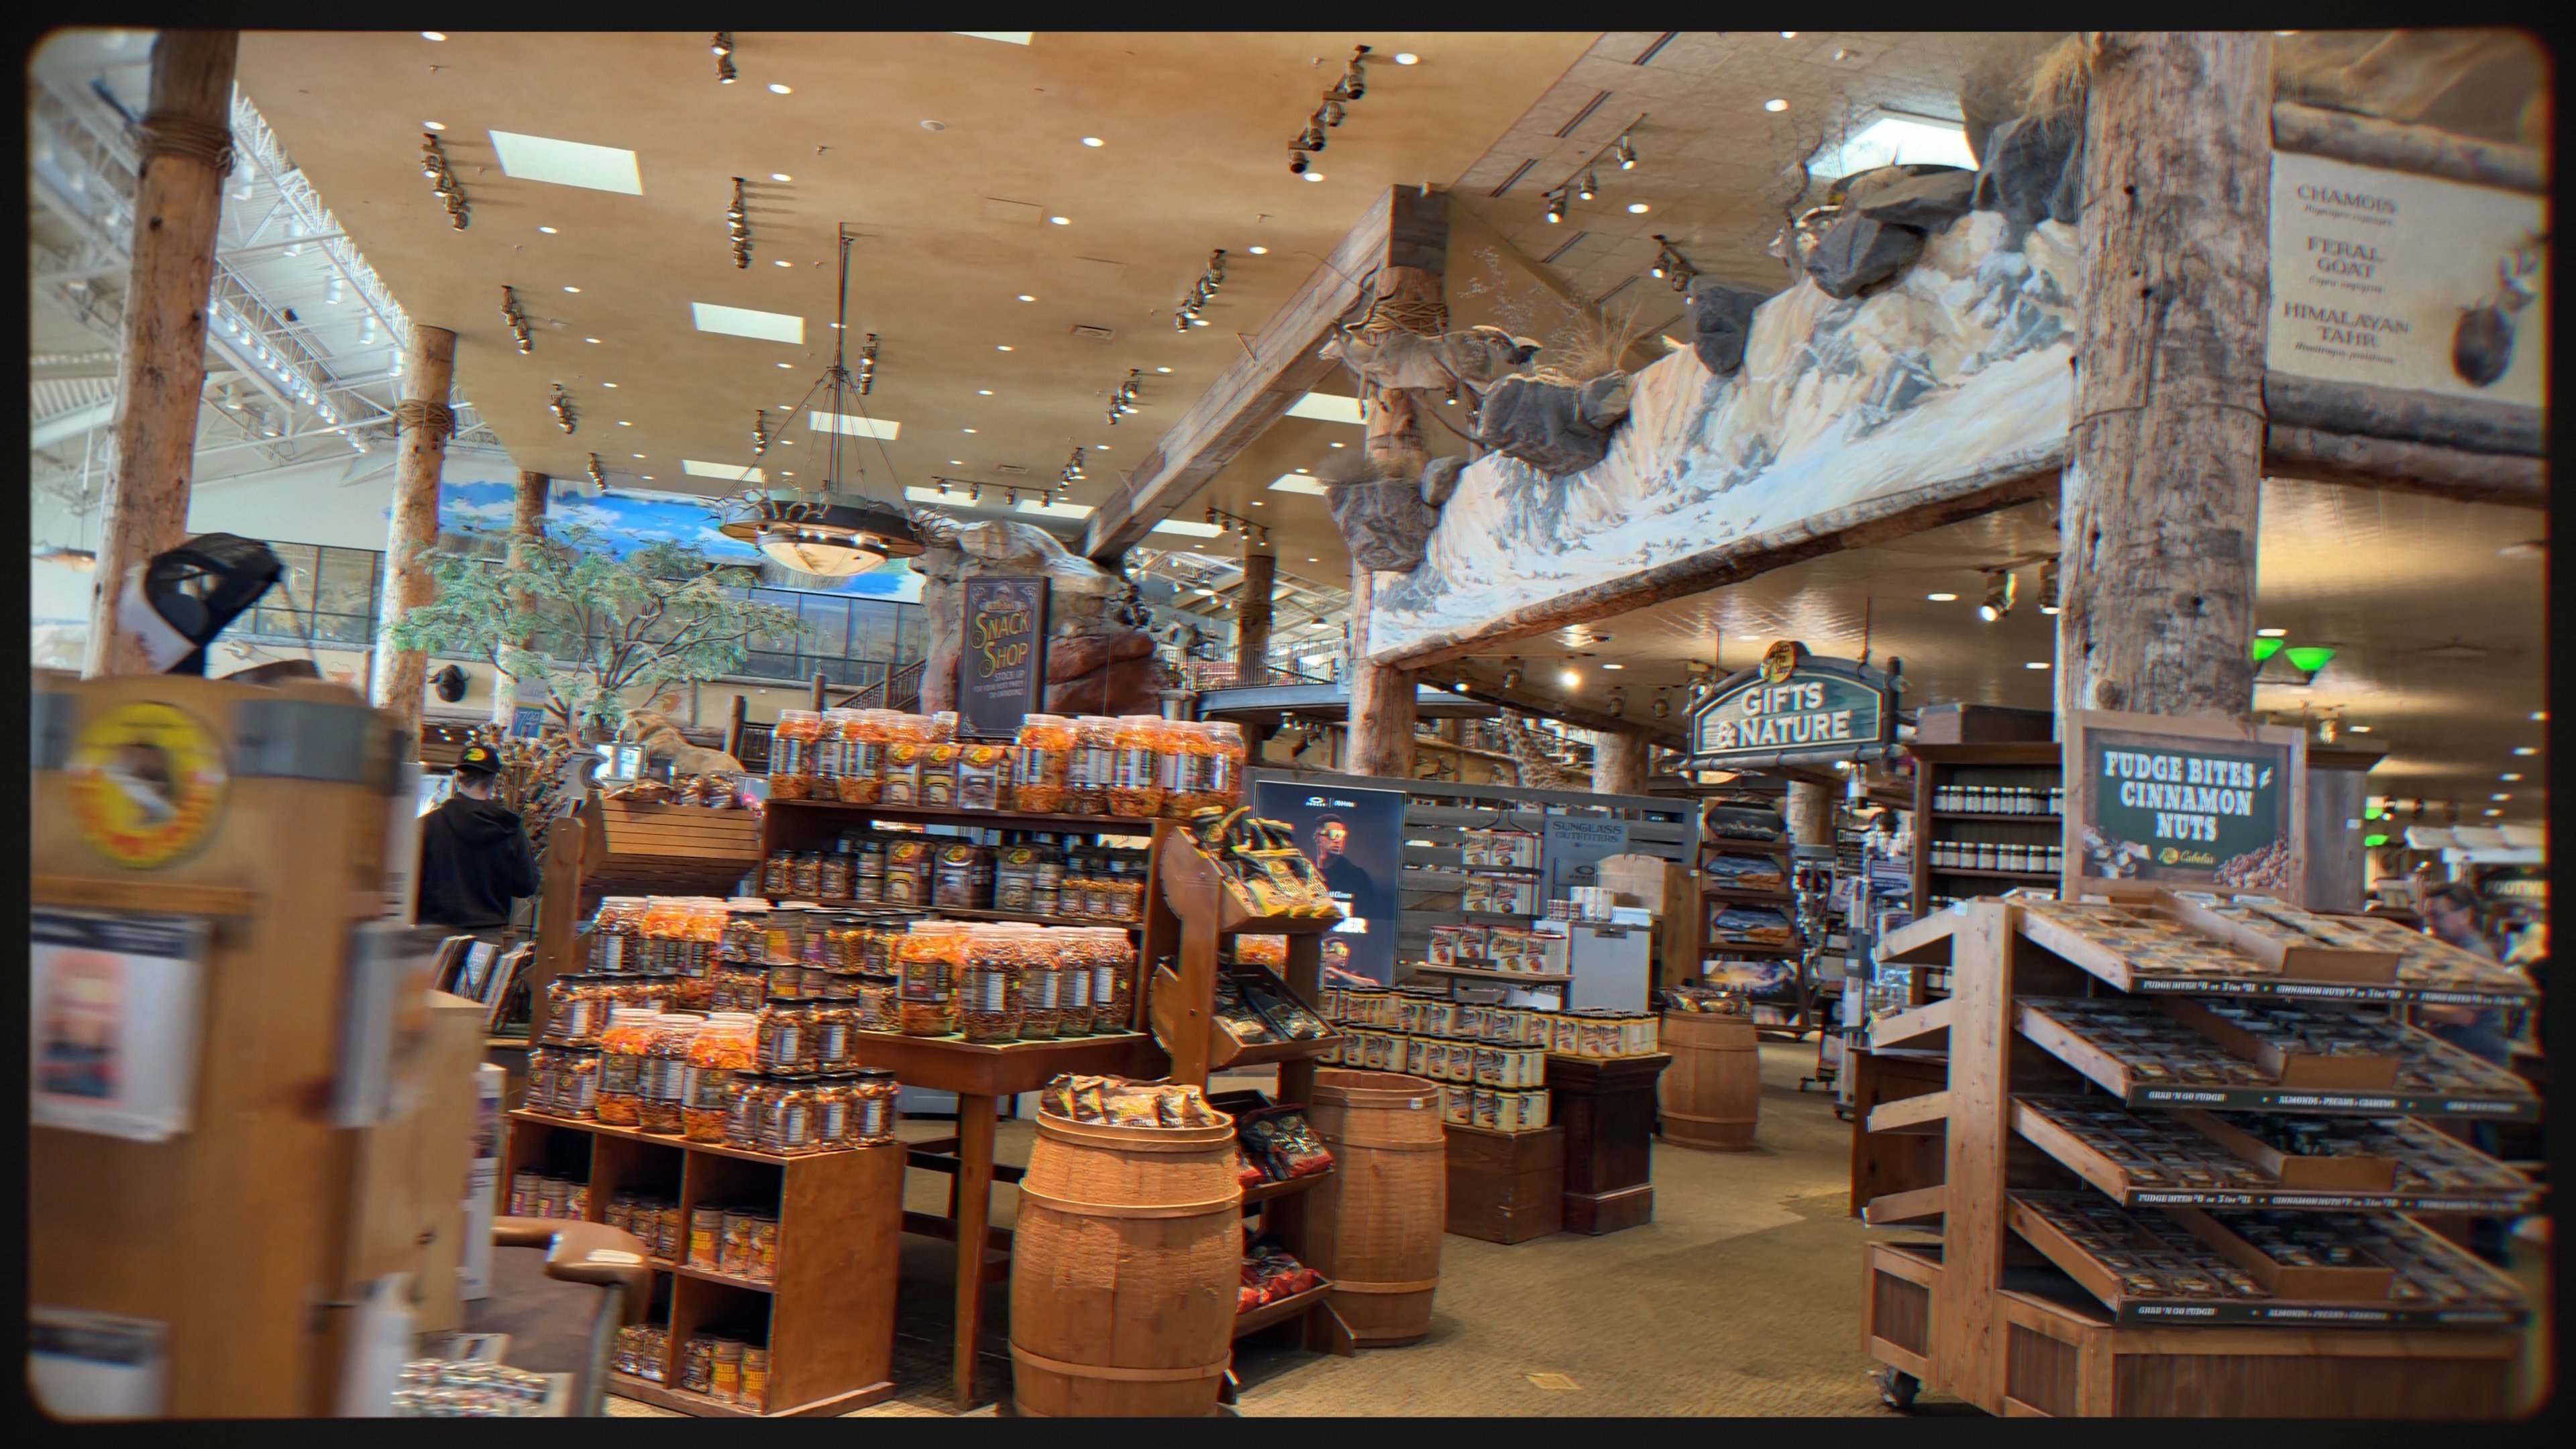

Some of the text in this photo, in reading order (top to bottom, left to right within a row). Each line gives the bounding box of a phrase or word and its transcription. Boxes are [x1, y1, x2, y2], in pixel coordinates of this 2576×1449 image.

[2297, 184, 2397, 215] CHAMOIS
[2307, 235, 2383, 264] FERAL
[2316, 256, 2375, 280] GOAT
[2284, 301, 2411, 335] HIMALAYAN
[2316, 325, 2379, 349] TAHR
[972, 610, 1032, 649] SNACK
[979, 641, 1030, 678] SHOP
[1741, 681, 1825, 717] GIFTS
[1716, 708, 1853, 749] & NATURE
[2104, 750, 2184, 782] FUDGE
[2187, 757, 2256, 789] BITES
[2120, 780, 2255, 816] CINNAMON
[1552, 820, 1622, 835] SUNGLASS
[1555, 831, 1619, 843] OUTFITTERS
[2155, 812, 2218, 843] NUTS
[2275, 985, 2322, 996] CINNAMON
[2137, 1193, 2167, 1203] FUDGE
